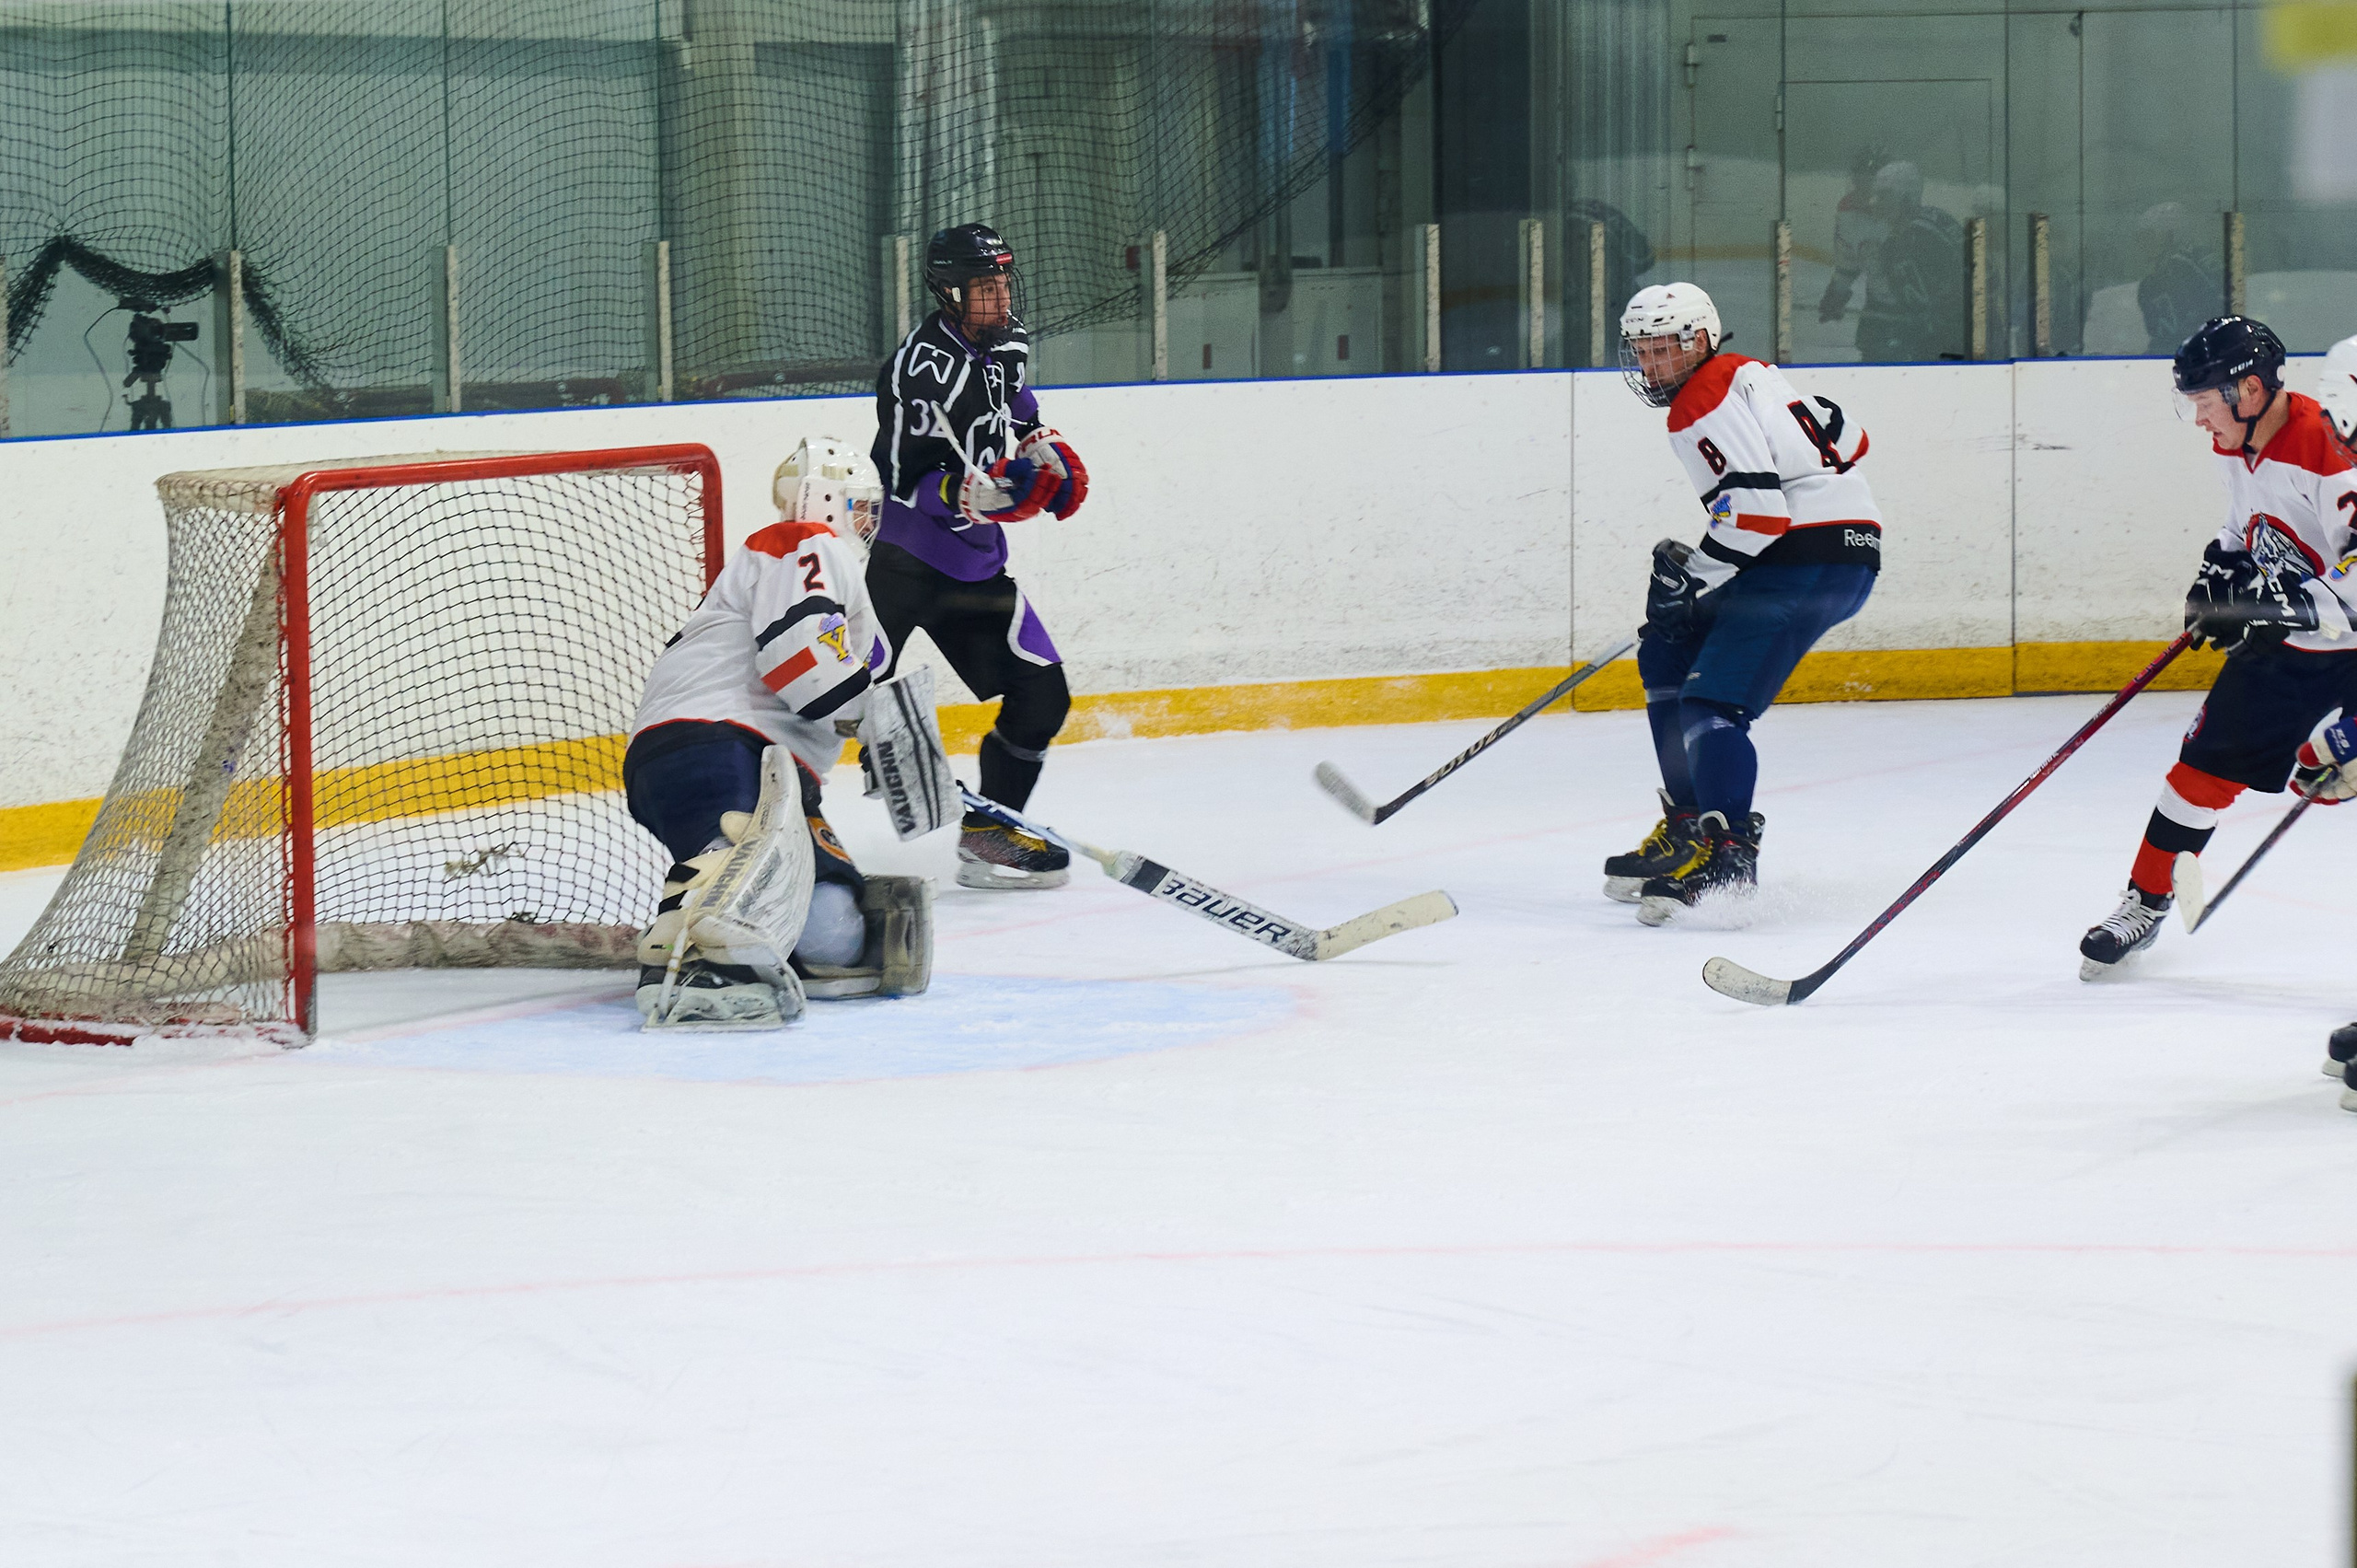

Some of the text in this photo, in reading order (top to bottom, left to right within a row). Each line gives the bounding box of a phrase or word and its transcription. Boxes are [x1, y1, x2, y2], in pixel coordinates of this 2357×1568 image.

[2229, 358, 2254, 376] CCM
[1697, 436, 1727, 476] 8
[1843, 528, 1880, 552] Ree
[797, 552, 825, 593] 2
[877, 740, 916, 834] VAUGHN
